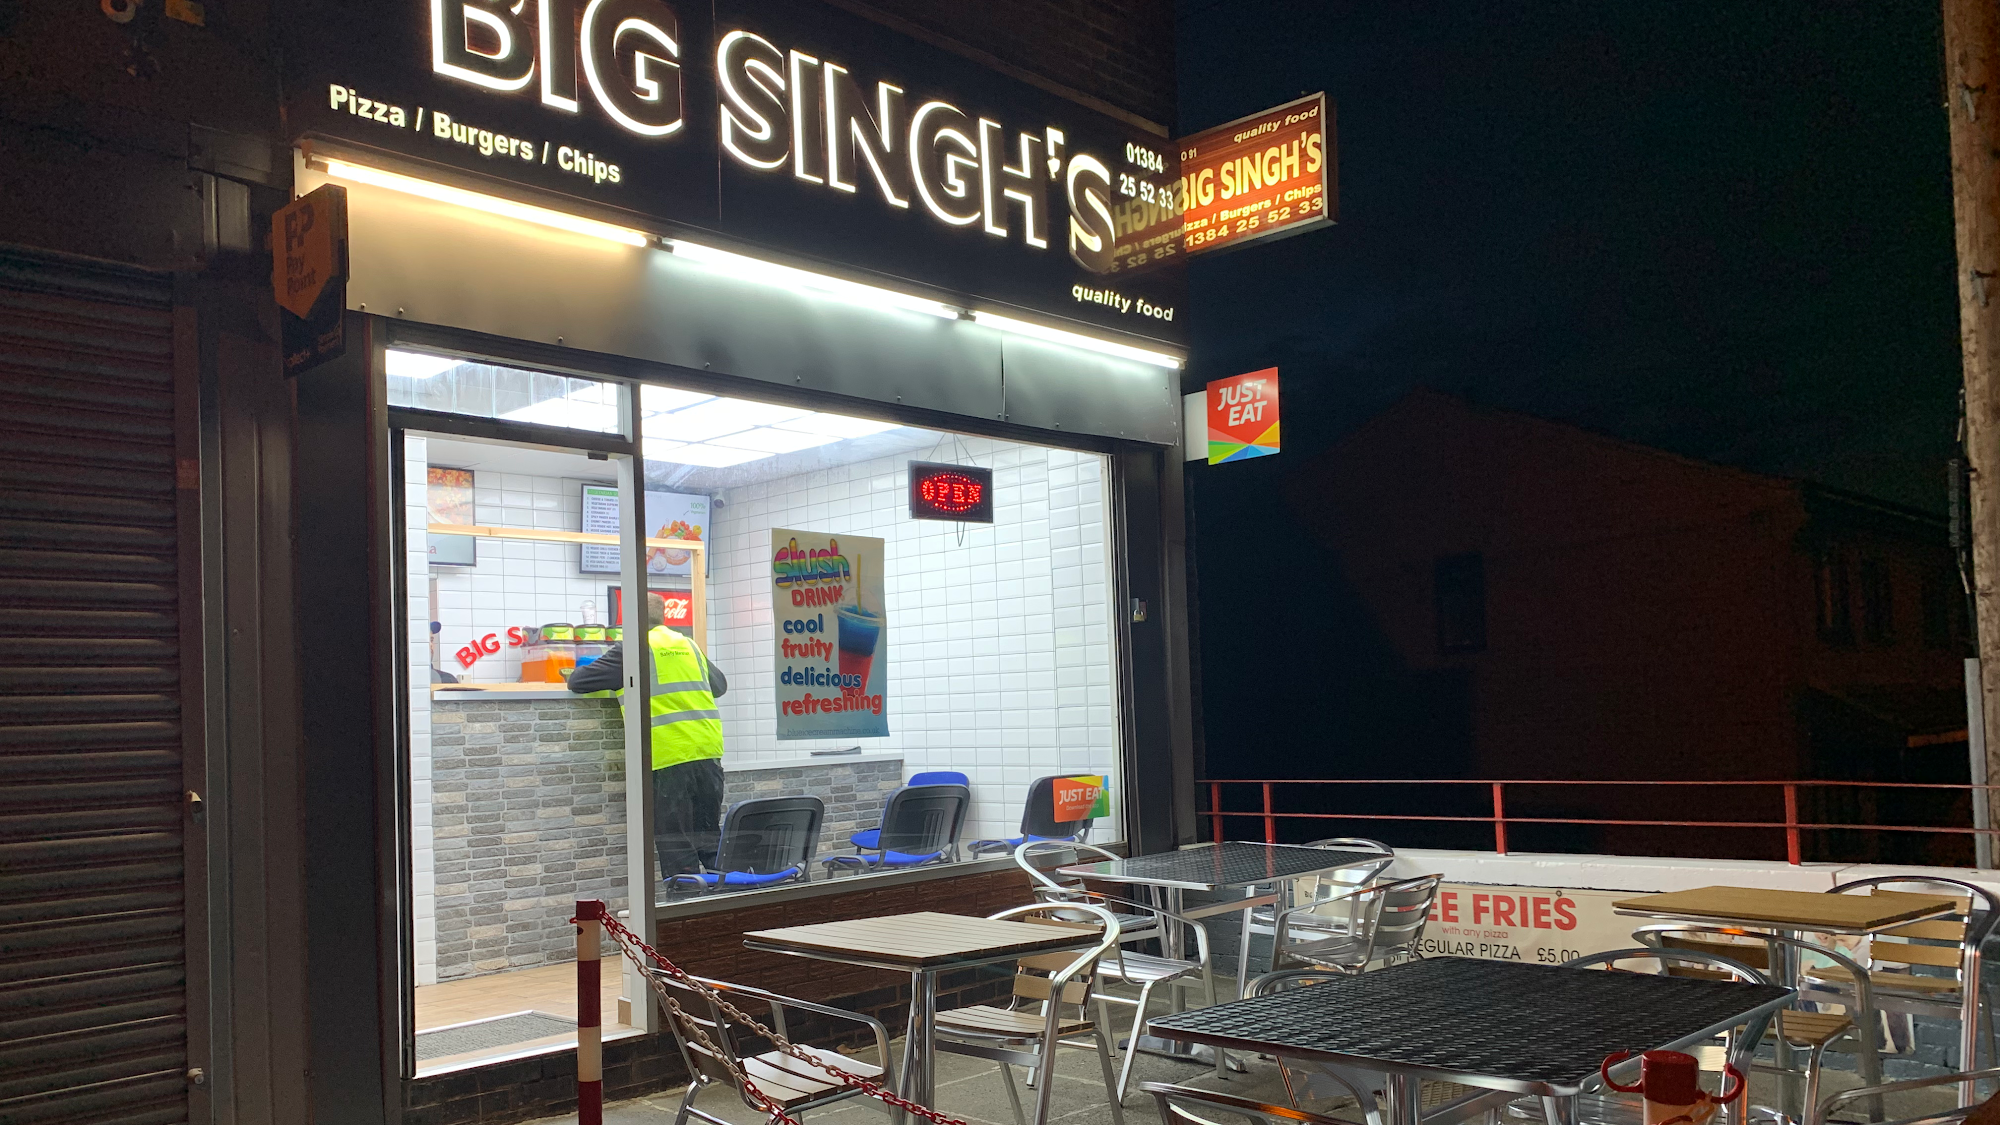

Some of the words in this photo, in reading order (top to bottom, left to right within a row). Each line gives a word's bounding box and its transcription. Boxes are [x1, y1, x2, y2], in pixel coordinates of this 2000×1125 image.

[329, 84, 405, 128] Pizza
[415, 107, 424, 131] /
[432, 111, 534, 156] Burgers
[541, 141, 550, 165] /
[557, 145, 621, 183] Chips
[431, 0, 683, 137] BIG
[716, 29, 1116, 274] SINGH'S
[1233, 118, 1281, 144] quality
[1284, 105, 1319, 127] food
[1126, 142, 1163, 173] 01384
[1220, 131, 1322, 200] SINGH'S
[1120, 173, 1136, 197] 25
[1140, 181, 1155, 204] 52
[1158, 188, 1174, 210] 33
[1184, 216, 1208, 232] izza
[1220, 198, 1271, 222] Burgers
[1284, 183, 1322, 203] Chips
[1185, 225, 1229, 247] 1384
[1235, 215, 1259, 233] 25
[1267, 206, 1291, 223] 52
[1298, 197, 1323, 214] 33
[1072, 284, 1131, 313] quality
[1136, 298, 1174, 321] food
[1217, 379, 1267, 411] JUST
[1228, 400, 1267, 427] EAT
[921, 480, 982, 503] OPEN
[792, 585, 845, 607] DRINK
[783, 613, 824, 634] cool
[455, 633, 501, 669] BIG
[781, 637, 833, 662] fruity
[780, 666, 862, 688] delicious
[781, 689, 882, 716] refreshing
[1058, 788, 1084, 805] JUST
[1086, 786, 1104, 800] EAT
[1472, 893, 1577, 931] FRIES
[1442, 926, 1461, 935] with
[1463, 929, 1481, 938] any
[1483, 929, 1508, 939] pizza
[1479, 943, 1521, 960] PIZZA
